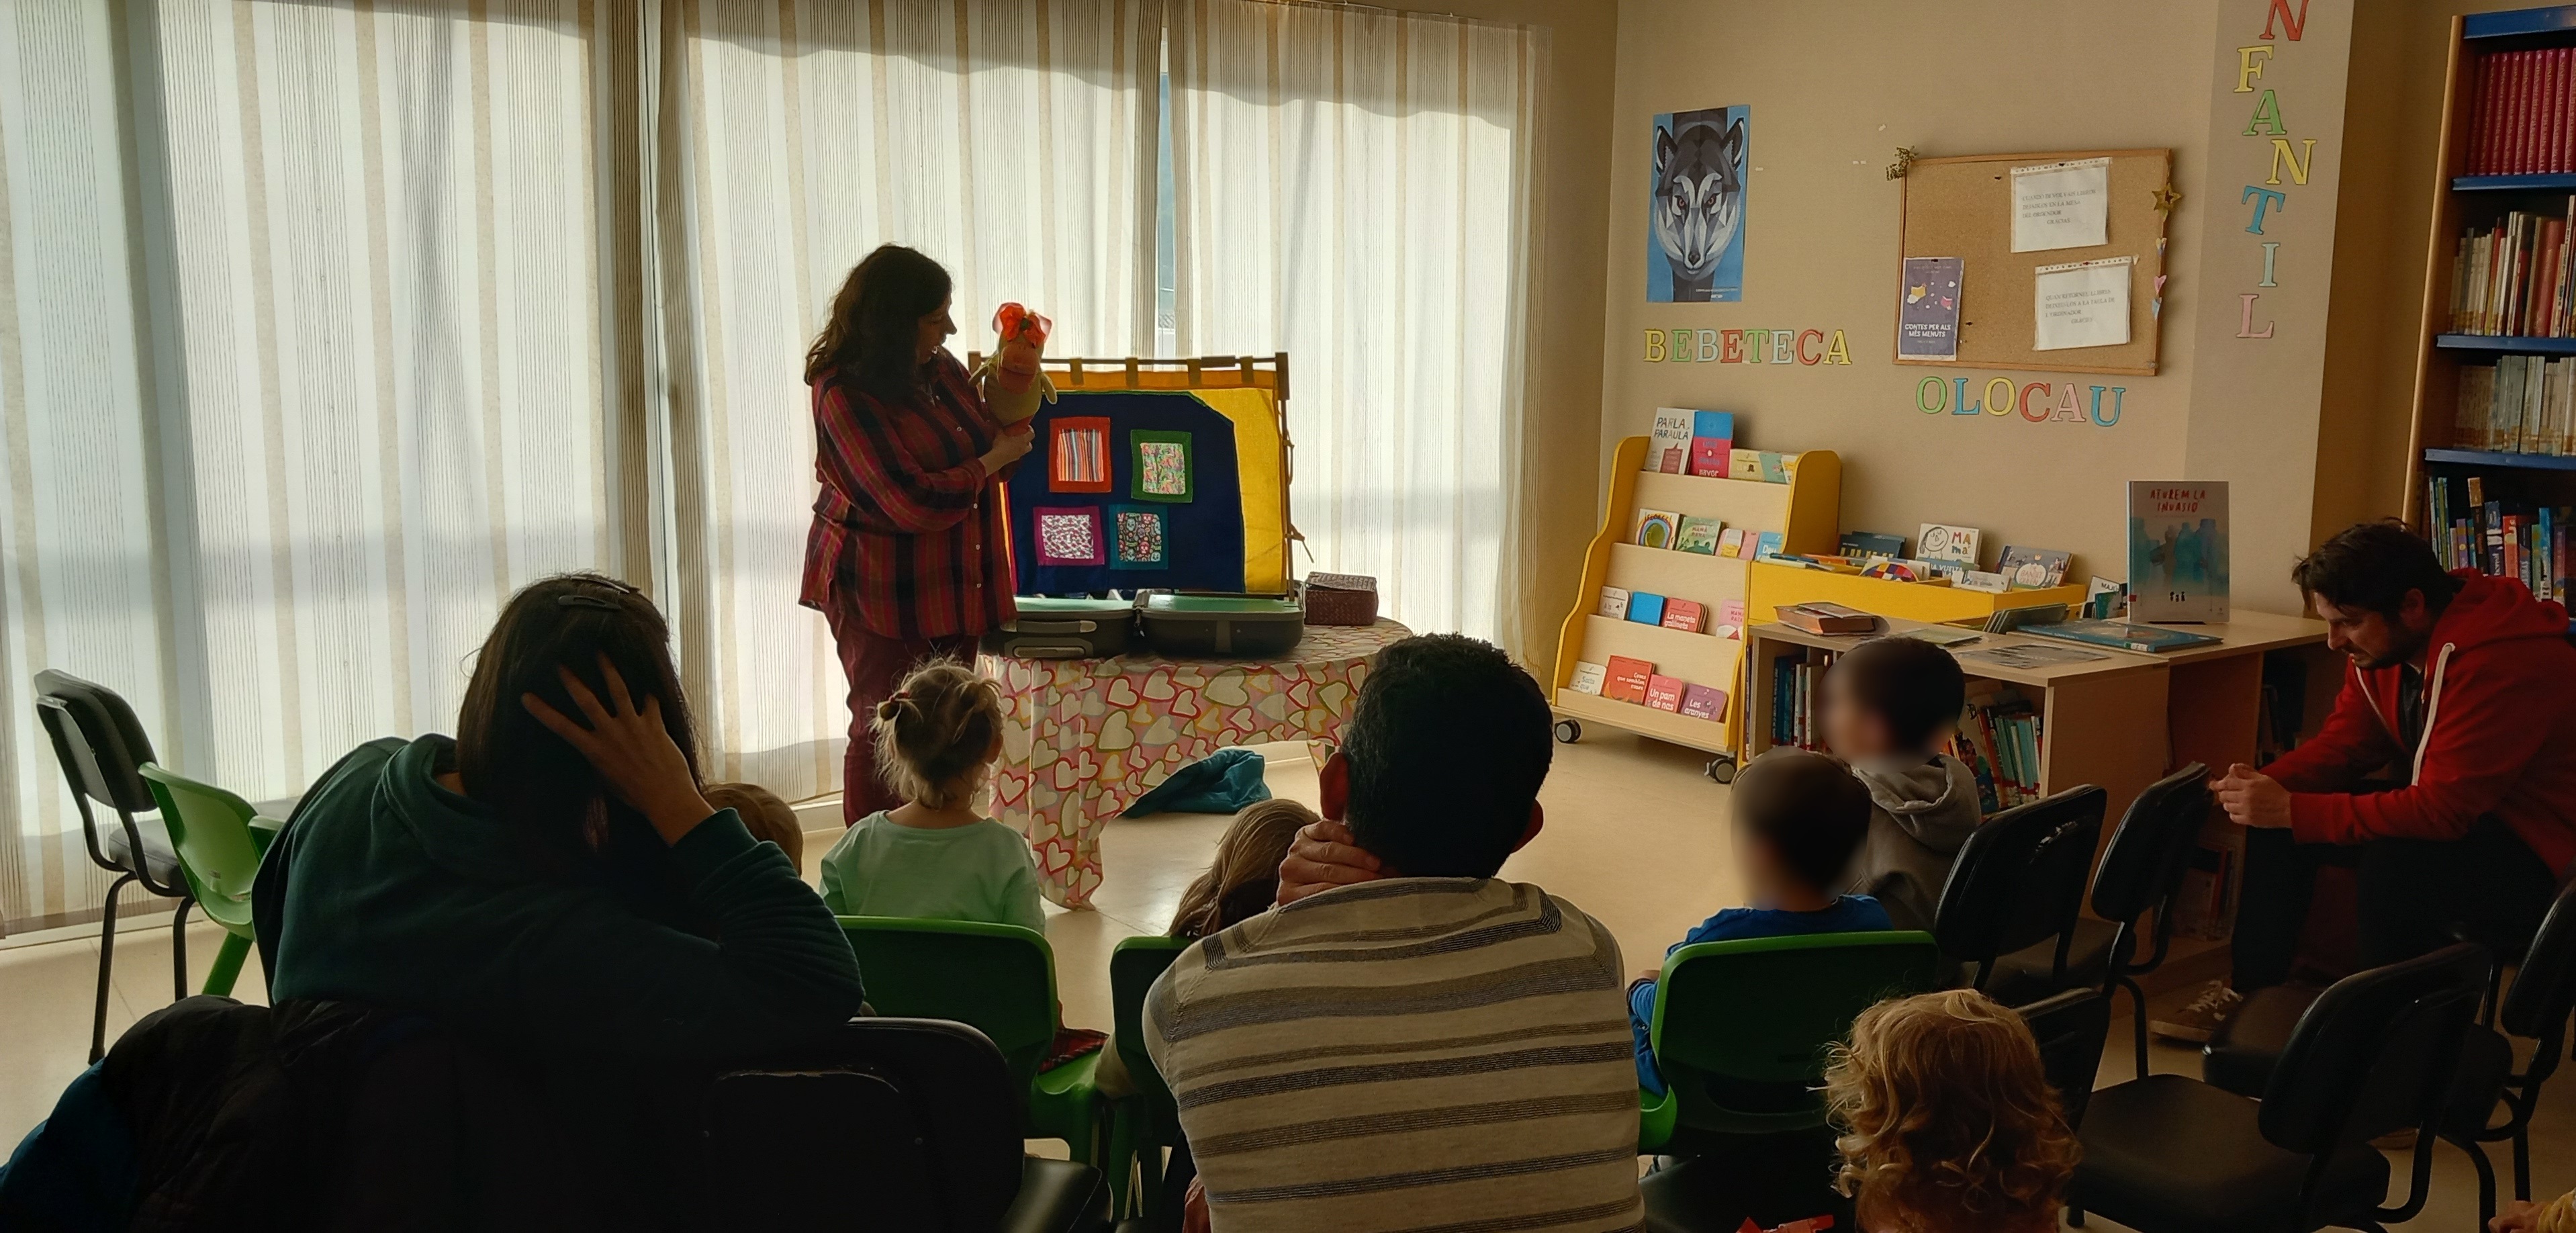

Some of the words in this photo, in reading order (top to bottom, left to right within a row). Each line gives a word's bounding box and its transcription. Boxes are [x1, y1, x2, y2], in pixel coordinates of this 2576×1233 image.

[1921, 330, 1946, 338] MENUTS
[1940, 324, 1951, 332] ALS
[1643, 328, 1852, 365] BEBETECA
[1916, 376, 2126, 427] OLOCAU
[1654, 428, 1689, 441] PARAULA
[2150, 489, 2190, 500] ATUREM
[2193, 489, 2206, 500] LA
[2158, 500, 2199, 512] INVASIÓ
[1951, 531, 1971, 545] MA
[1667, 612, 1675, 620] La
[1650, 688, 1659, 698] Un
[1659, 692, 1675, 702] pam
[1652, 699, 1661, 709] de
[1661, 702, 1674, 711] nas
[1690, 699, 1702, 709] Les
[1684, 707, 1710, 719] aranyes
